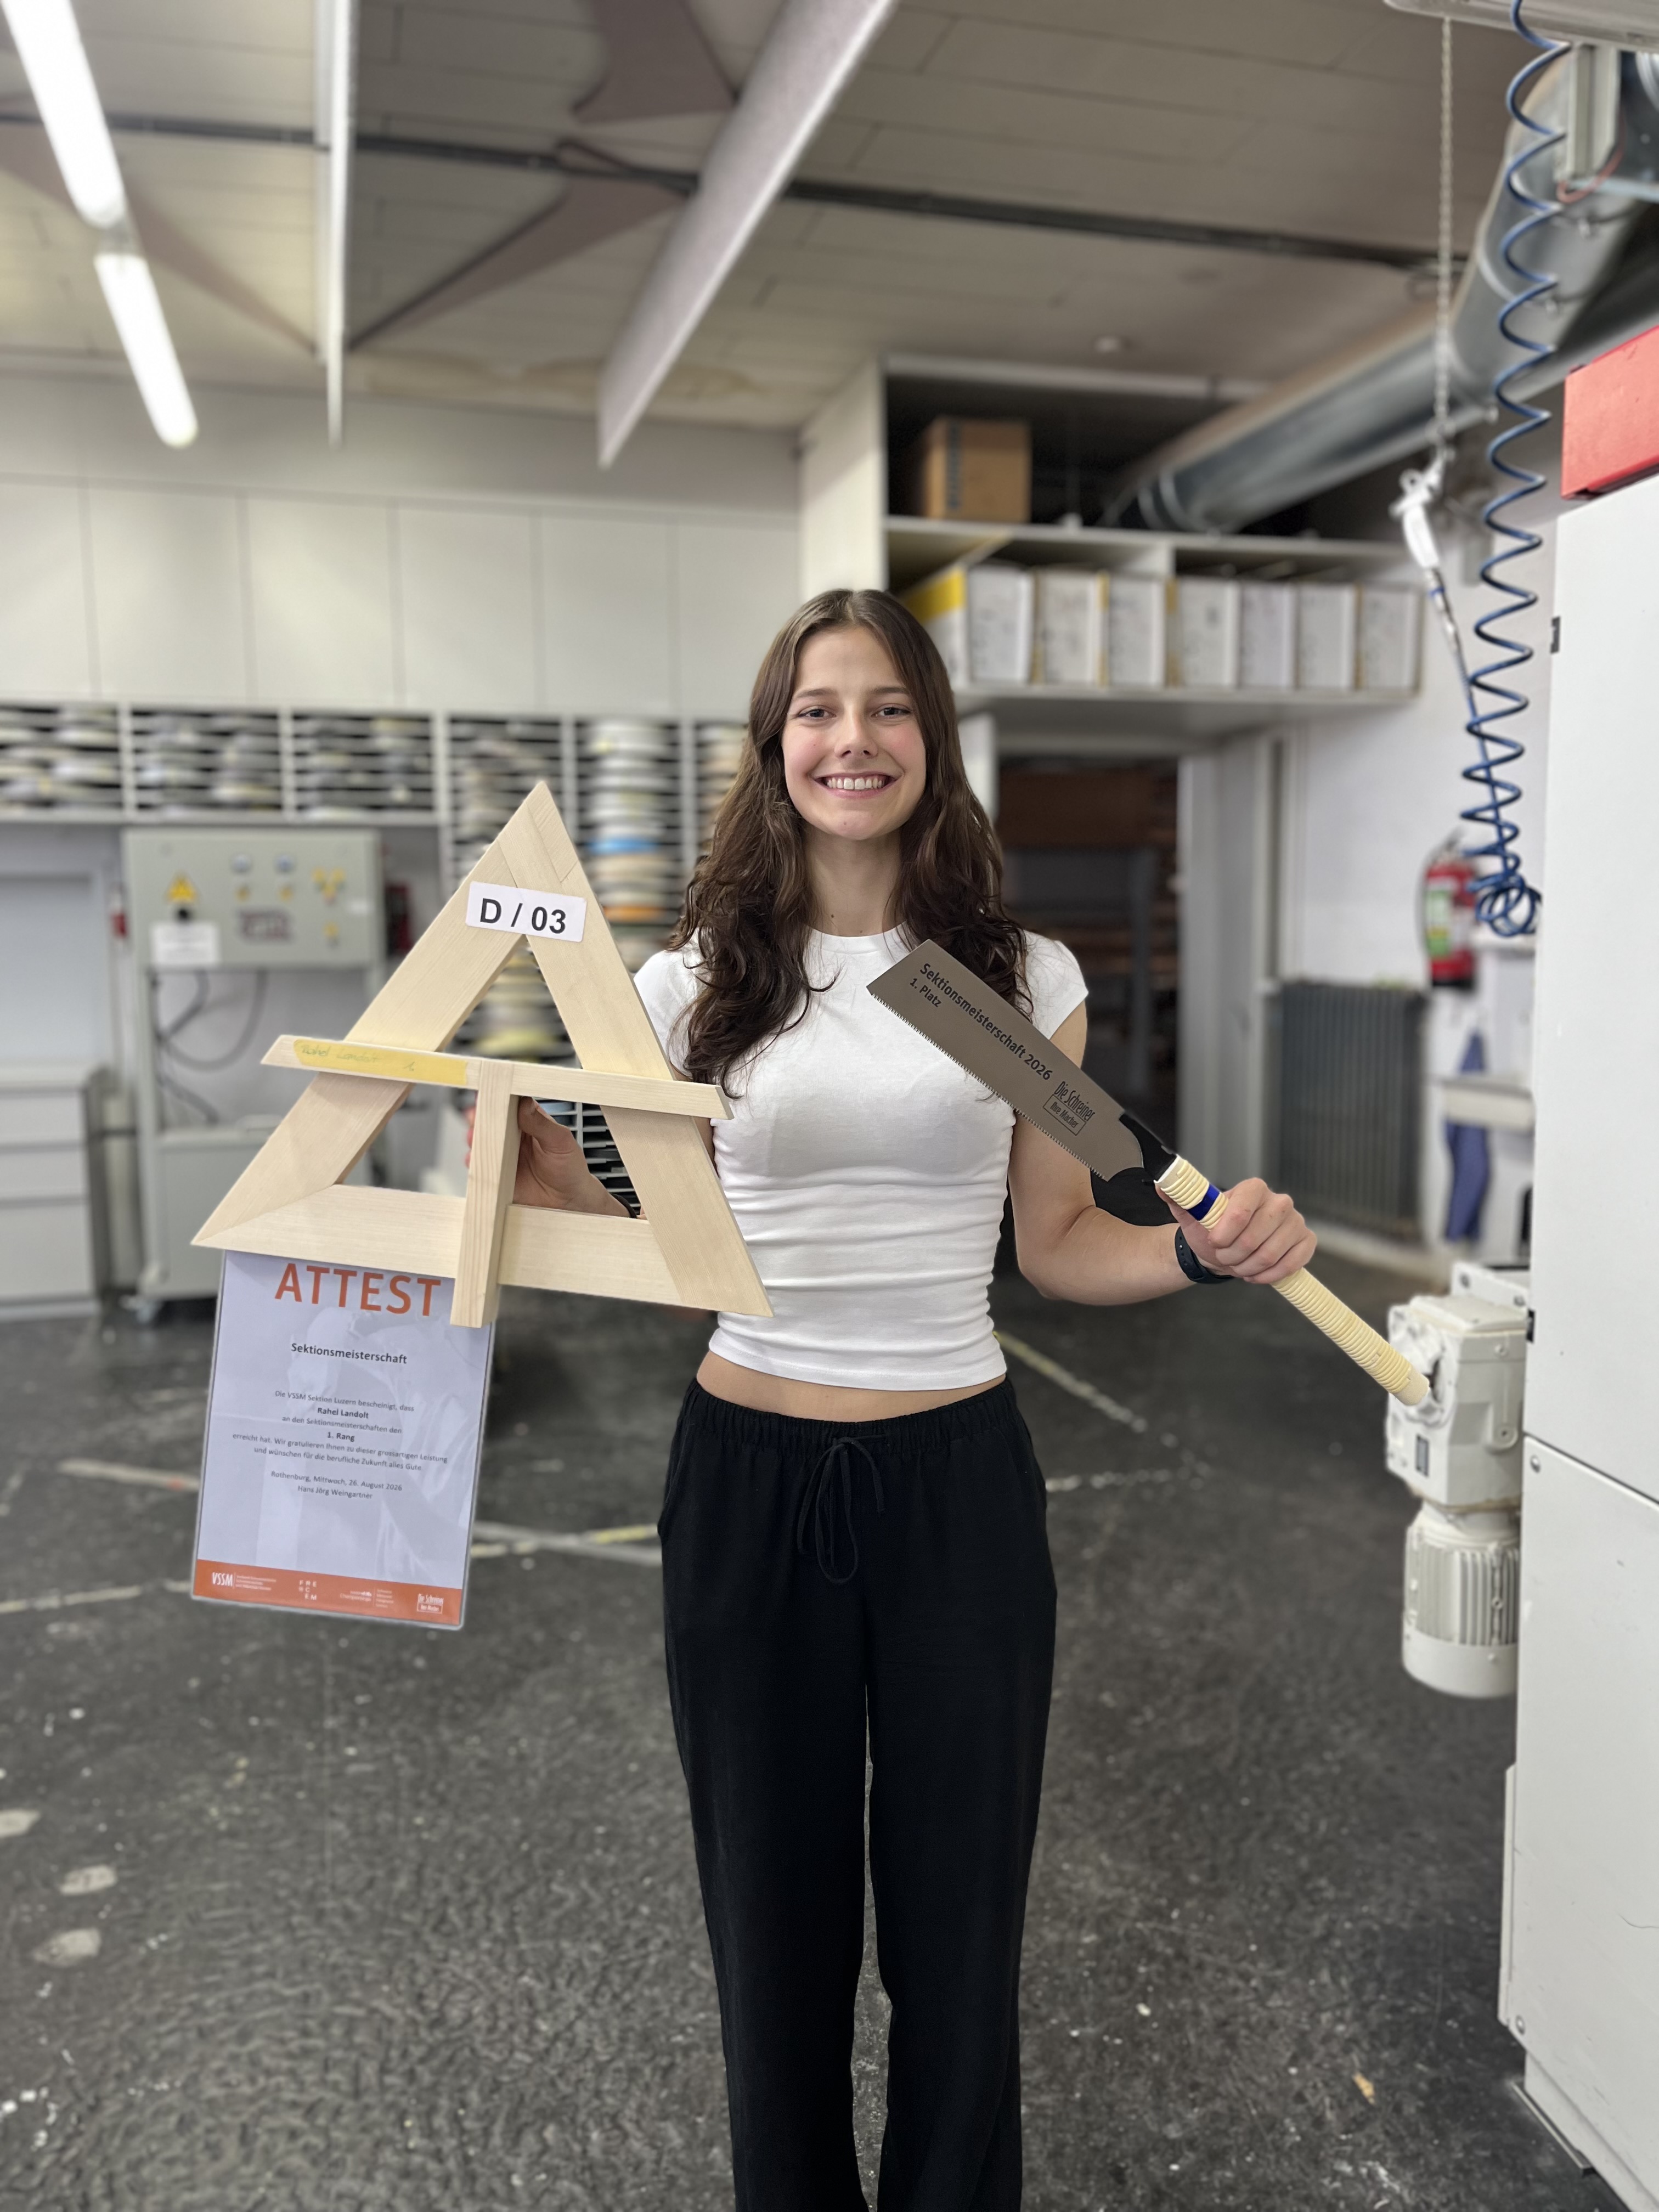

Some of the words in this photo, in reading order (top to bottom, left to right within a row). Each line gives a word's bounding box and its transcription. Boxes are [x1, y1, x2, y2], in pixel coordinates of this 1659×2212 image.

[479, 898, 501, 924] D
[511, 902, 523, 927] /
[531, 906, 566, 934] 03
[909, 978, 918, 989] 1.
[919, 985, 942, 1008] Platz
[919, 963, 1027, 1059] Sektionsmeisterschaft
[1024, 1054, 1053, 1080] 2026
[1054, 1081, 1068, 1099] Die
[1064, 1090, 1095, 1121] Schreiner
[1050, 1102, 1061, 1114] Ihre
[1059, 1110, 1079, 1128] Macher
[274, 1263, 441, 1317] ATTEST
[291, 1342, 408, 1364] Sektionsmeisterschaft
[288, 1392, 306, 1400] VSSM
[308, 1395, 332, 1403] Sektion
[358, 1400, 397, 1411] bescheinigt,
[292, 1415, 304, 1424] den
[307, 1418, 387, 1432] Sektionsmeisterschaften
[318, 1407, 338, 1415] Rahel
[341, 1409, 369, 1419] Landolt
[336, 1433, 355, 1442] Rang
[233, 1433, 258, 1442] erreicht
[287, 1440, 324, 1449] gratulieren
[326, 1443, 345, 1451] Ihnen
[356, 1446, 376, 1454] dieser
[377, 1450, 418, 1460] grossartigen
[420, 1454, 448, 1464] Leistung
[269, 1449, 302, 1458] wünschen
[327, 1453, 360, 1464] berufliche
[362, 1458, 387, 1468] Zukunft
[388, 1461, 403, 1469] alles
[271, 1471, 311, 1482] Rothenburg,
[313, 1476, 347, 1486] Mittwoch,
[360, 1481, 384, 1489] August
[315, 1487, 329, 1496] Jörg
[331, 1489, 373, 1499] Weingartner
[212, 1572, 233, 1587] VSSM
